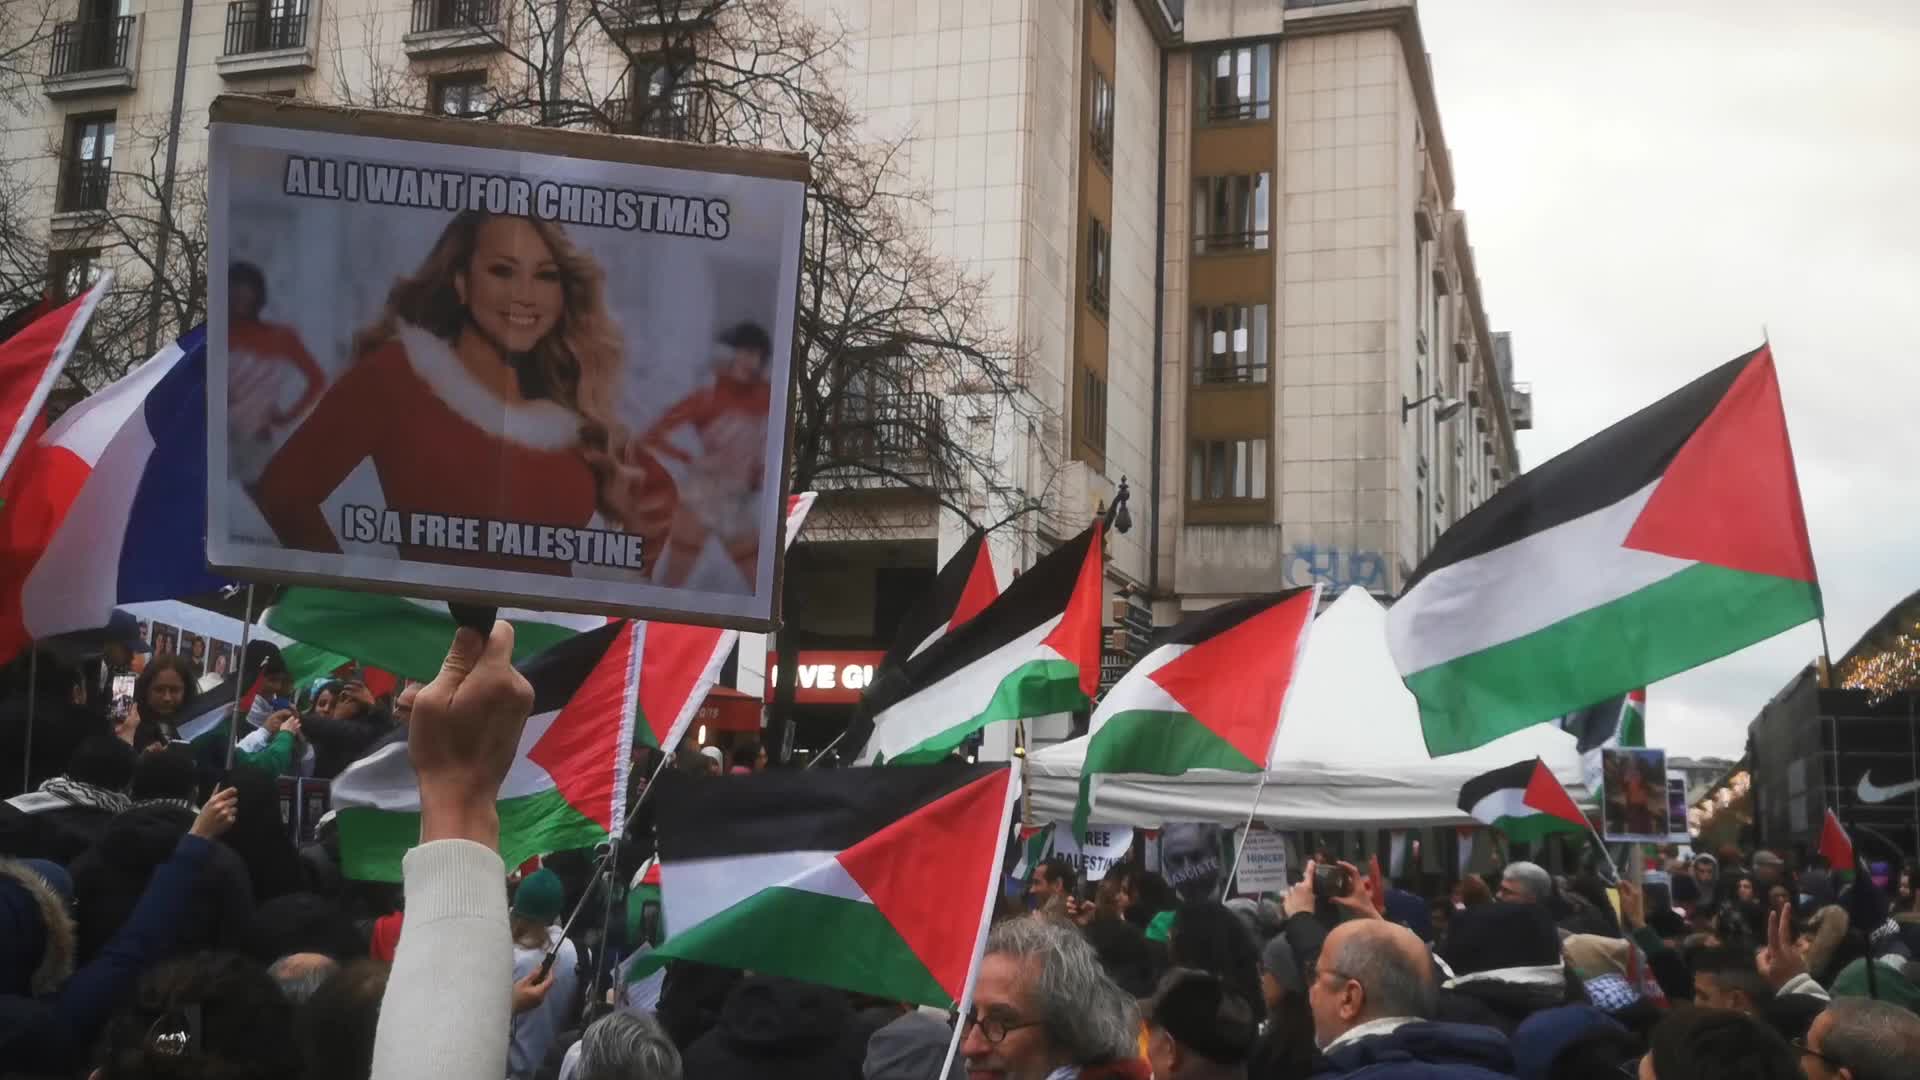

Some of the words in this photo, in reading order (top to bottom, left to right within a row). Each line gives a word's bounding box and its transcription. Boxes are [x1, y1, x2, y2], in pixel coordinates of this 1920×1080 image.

[285, 156, 341, 198] ALL
[345, 162, 360, 200] I
[364, 163, 465, 210] WANT
[467, 174, 531, 217] FOR
[536, 181, 729, 239] CHRISTMAS
[342, 505, 376, 542] IS
[381, 509, 402, 543] A
[409, 512, 480, 551] FREE
[486, 519, 643, 568] PALESTINE
[771, 664, 837, 689] VE
[1084, 831, 1111, 848] REE
